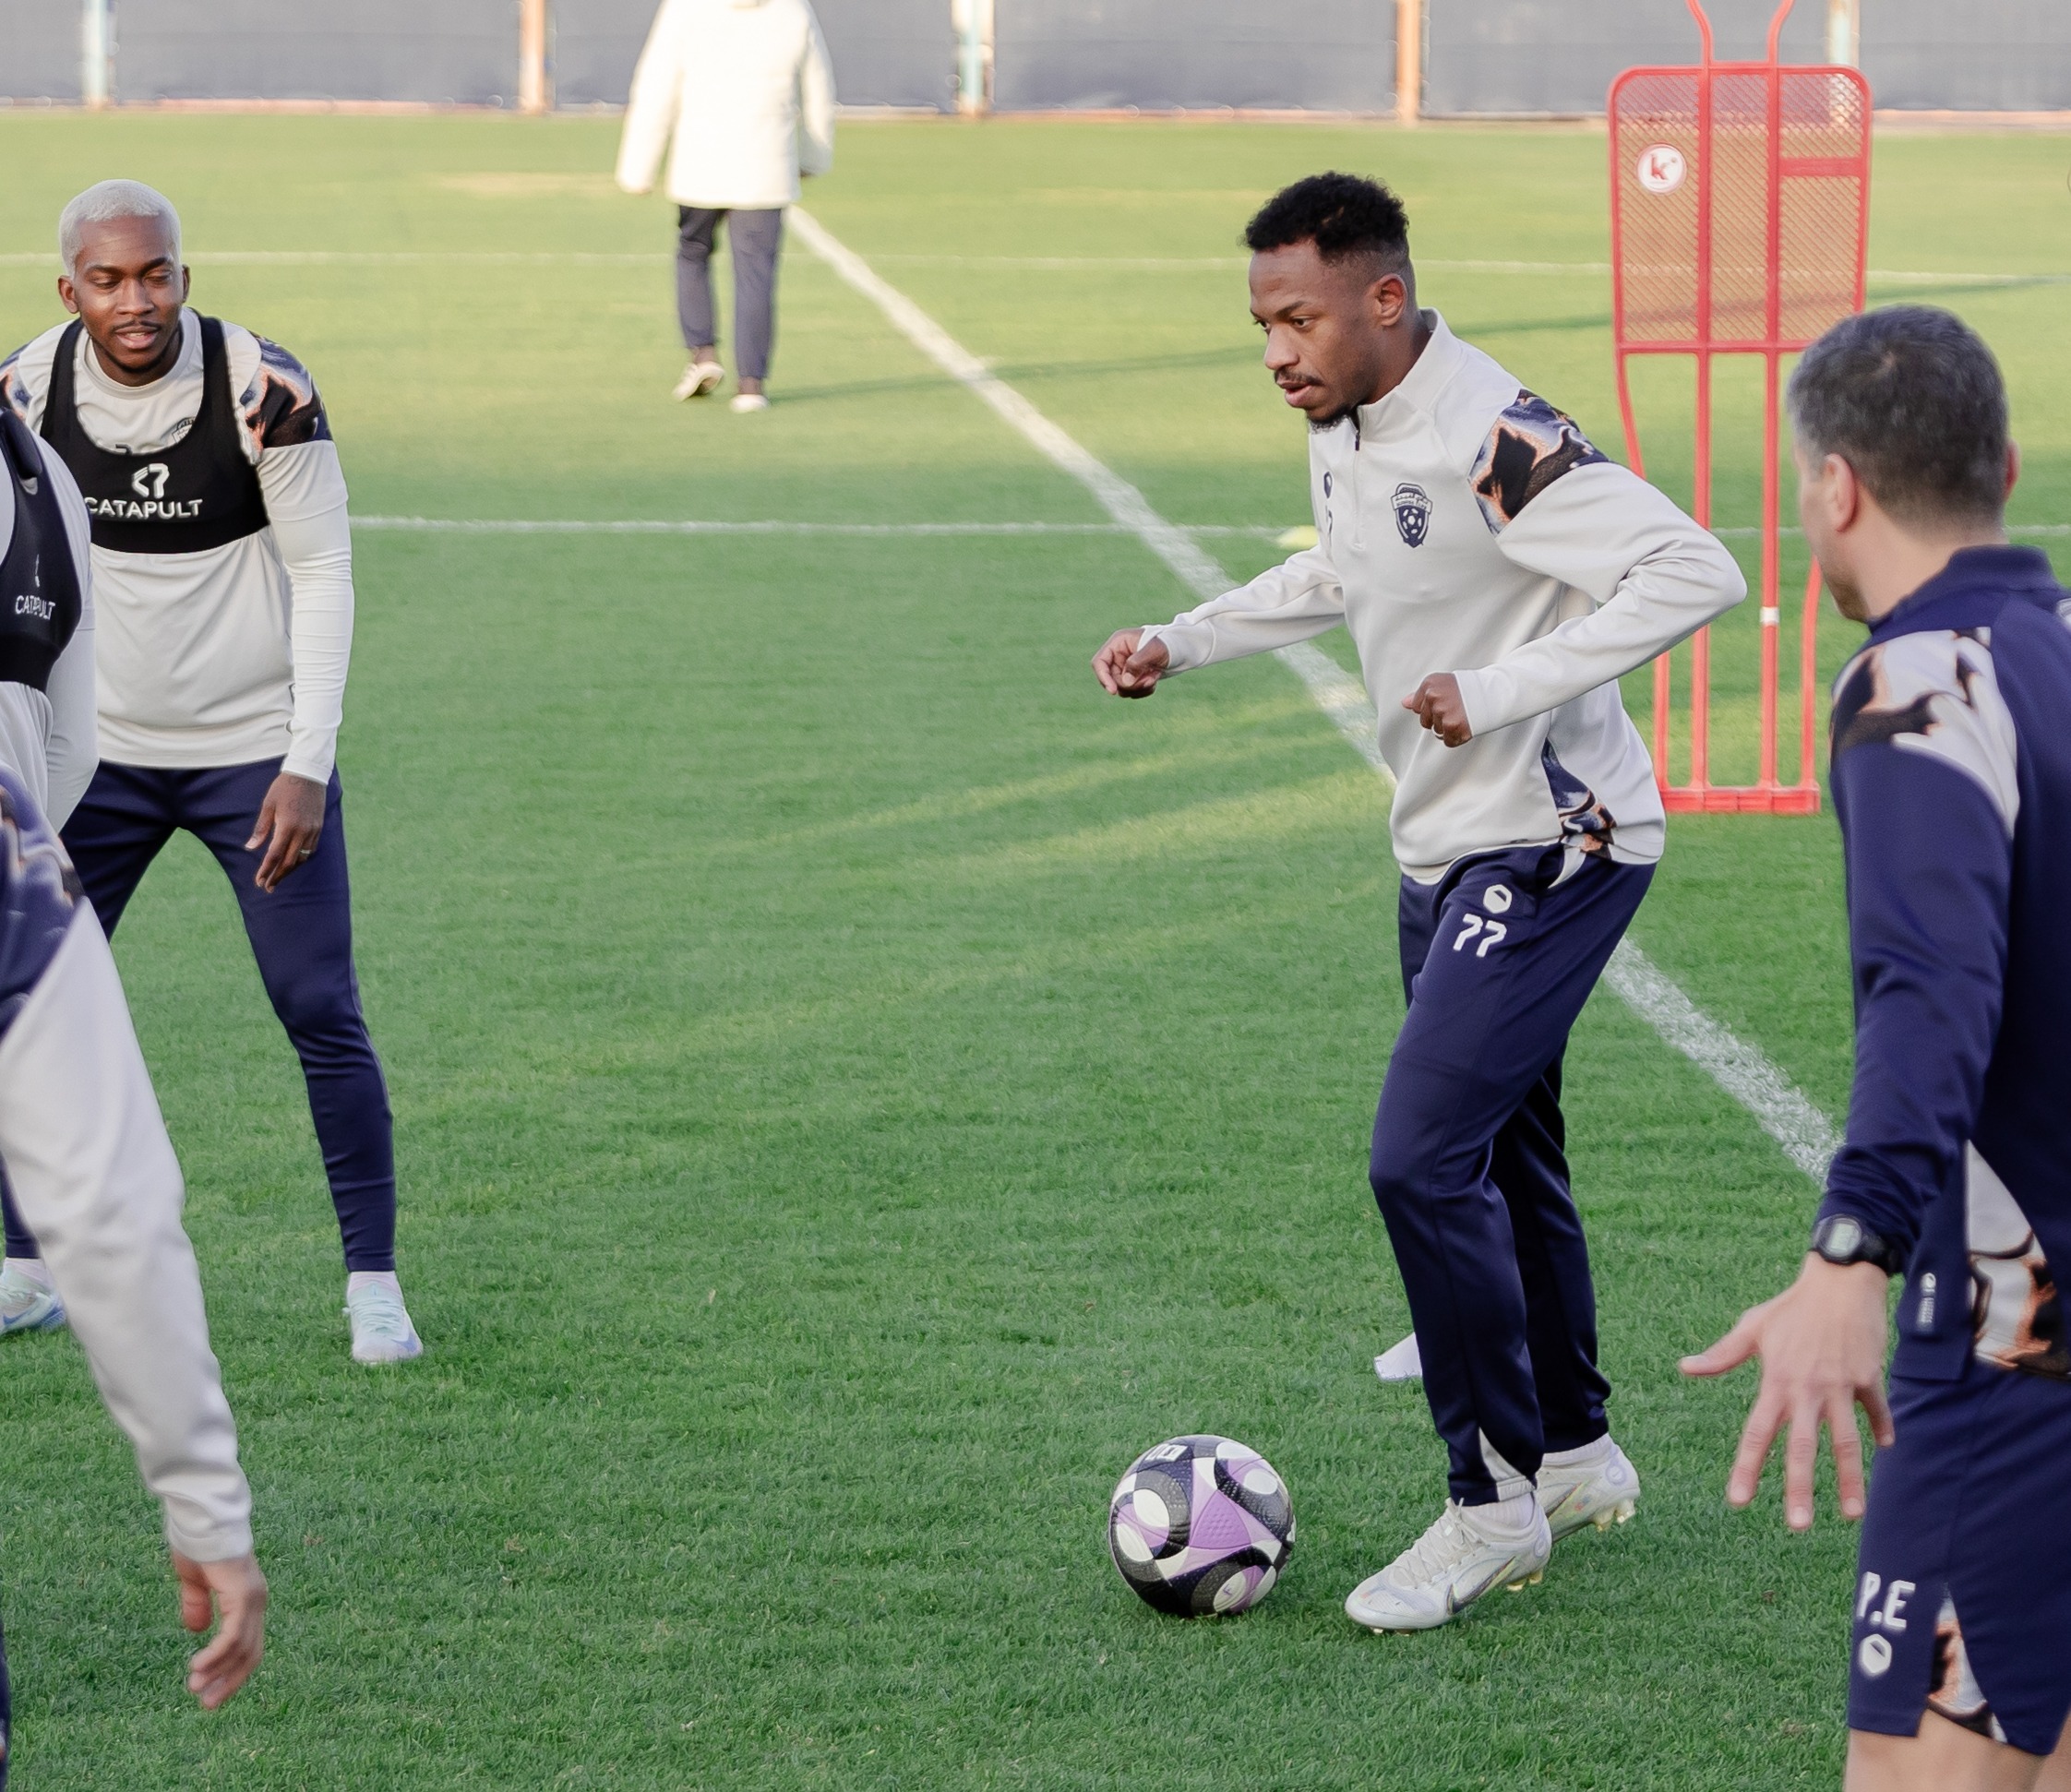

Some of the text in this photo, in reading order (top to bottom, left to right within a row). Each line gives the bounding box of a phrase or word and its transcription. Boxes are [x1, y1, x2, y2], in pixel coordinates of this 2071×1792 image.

[84, 496, 202, 519] CATAPULT
[1453, 913, 1507, 958] 77
[1856, 1571, 1916, 1631] P.E
